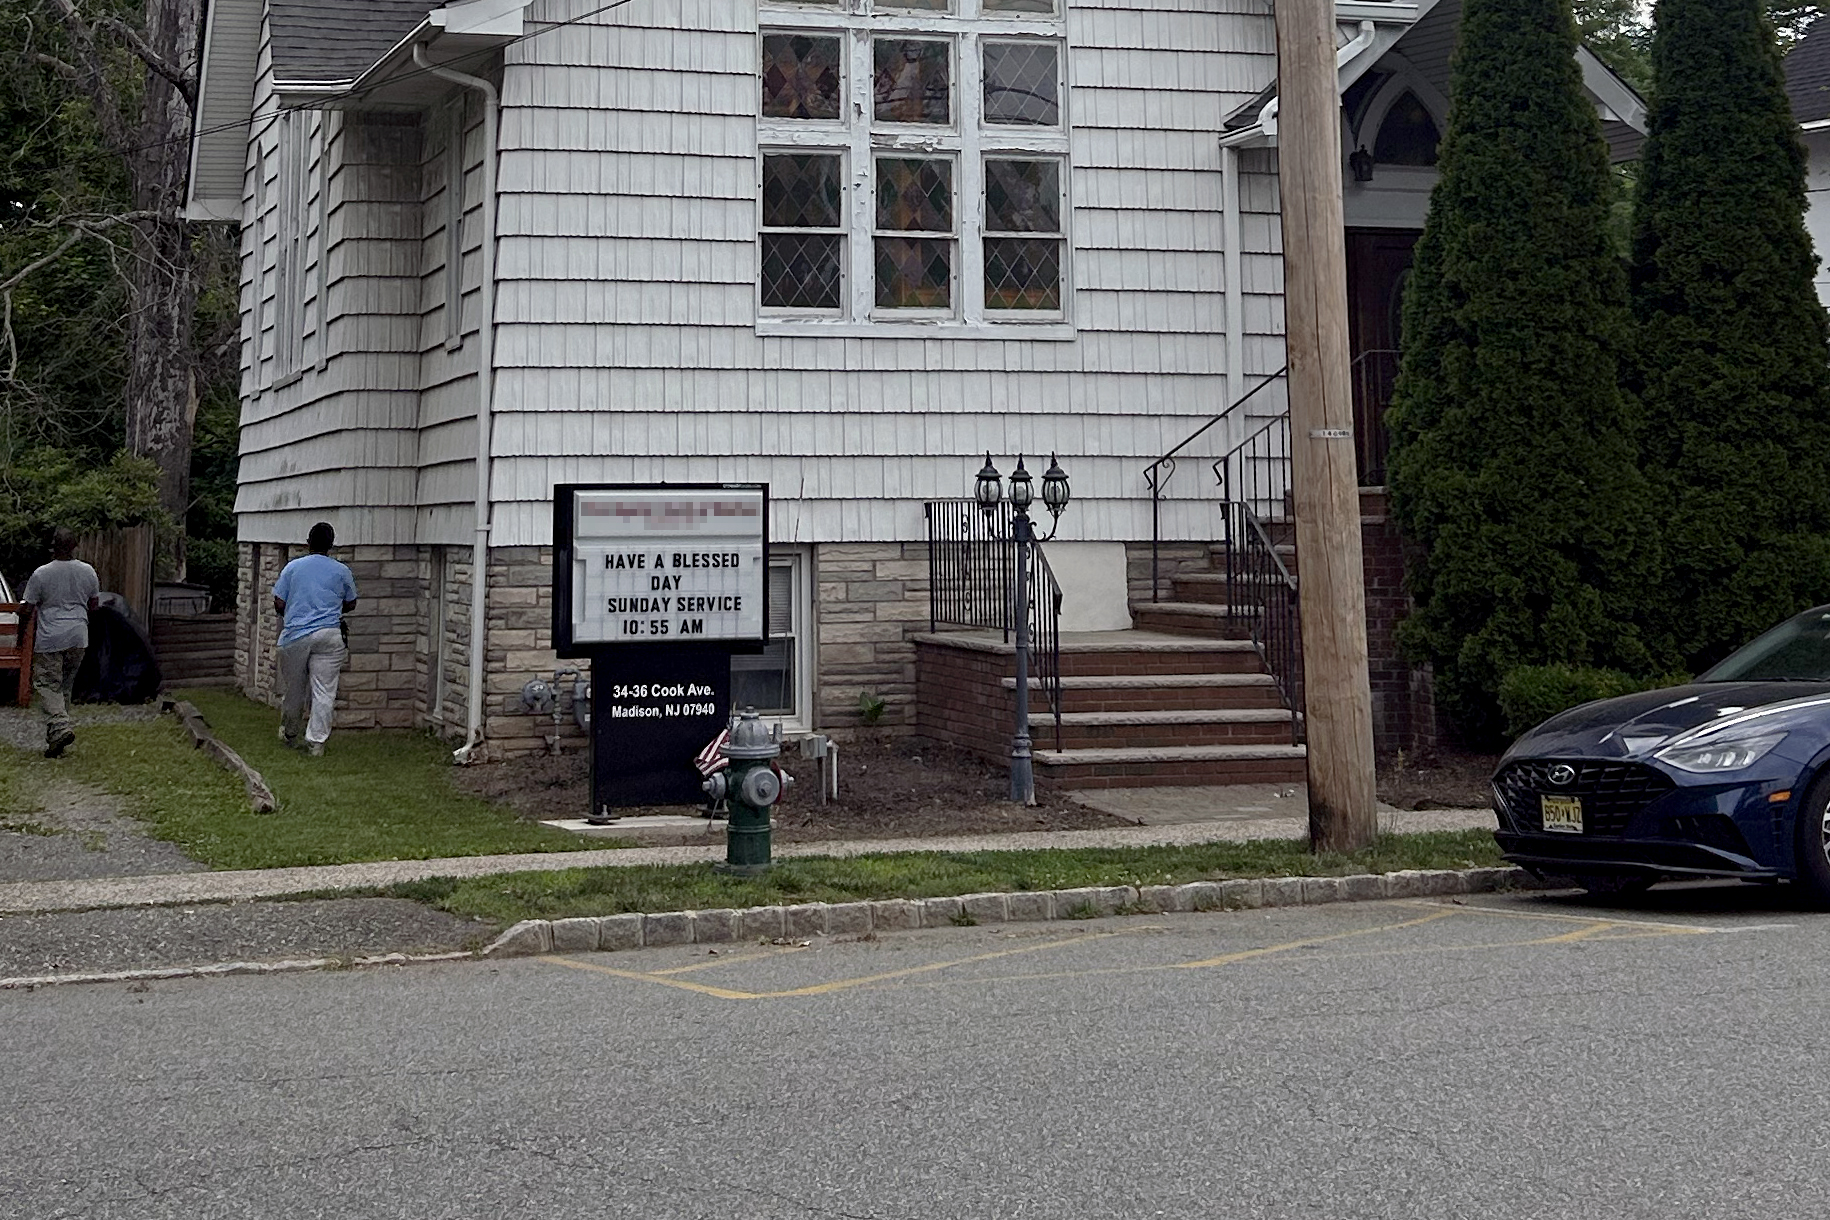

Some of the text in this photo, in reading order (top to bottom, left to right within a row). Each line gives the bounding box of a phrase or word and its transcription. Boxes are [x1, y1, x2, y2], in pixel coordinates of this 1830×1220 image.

[605, 553, 739, 569] HAVE A BLESSED
[651, 575, 682, 590] DAY
[608, 596, 742, 612] SUNDAY SERVICE
[680, 618, 703, 634] AM
[613, 682, 715, 698] 34-36 Cook Ave.
[611, 702, 715, 719] Madison, NJ 07940
